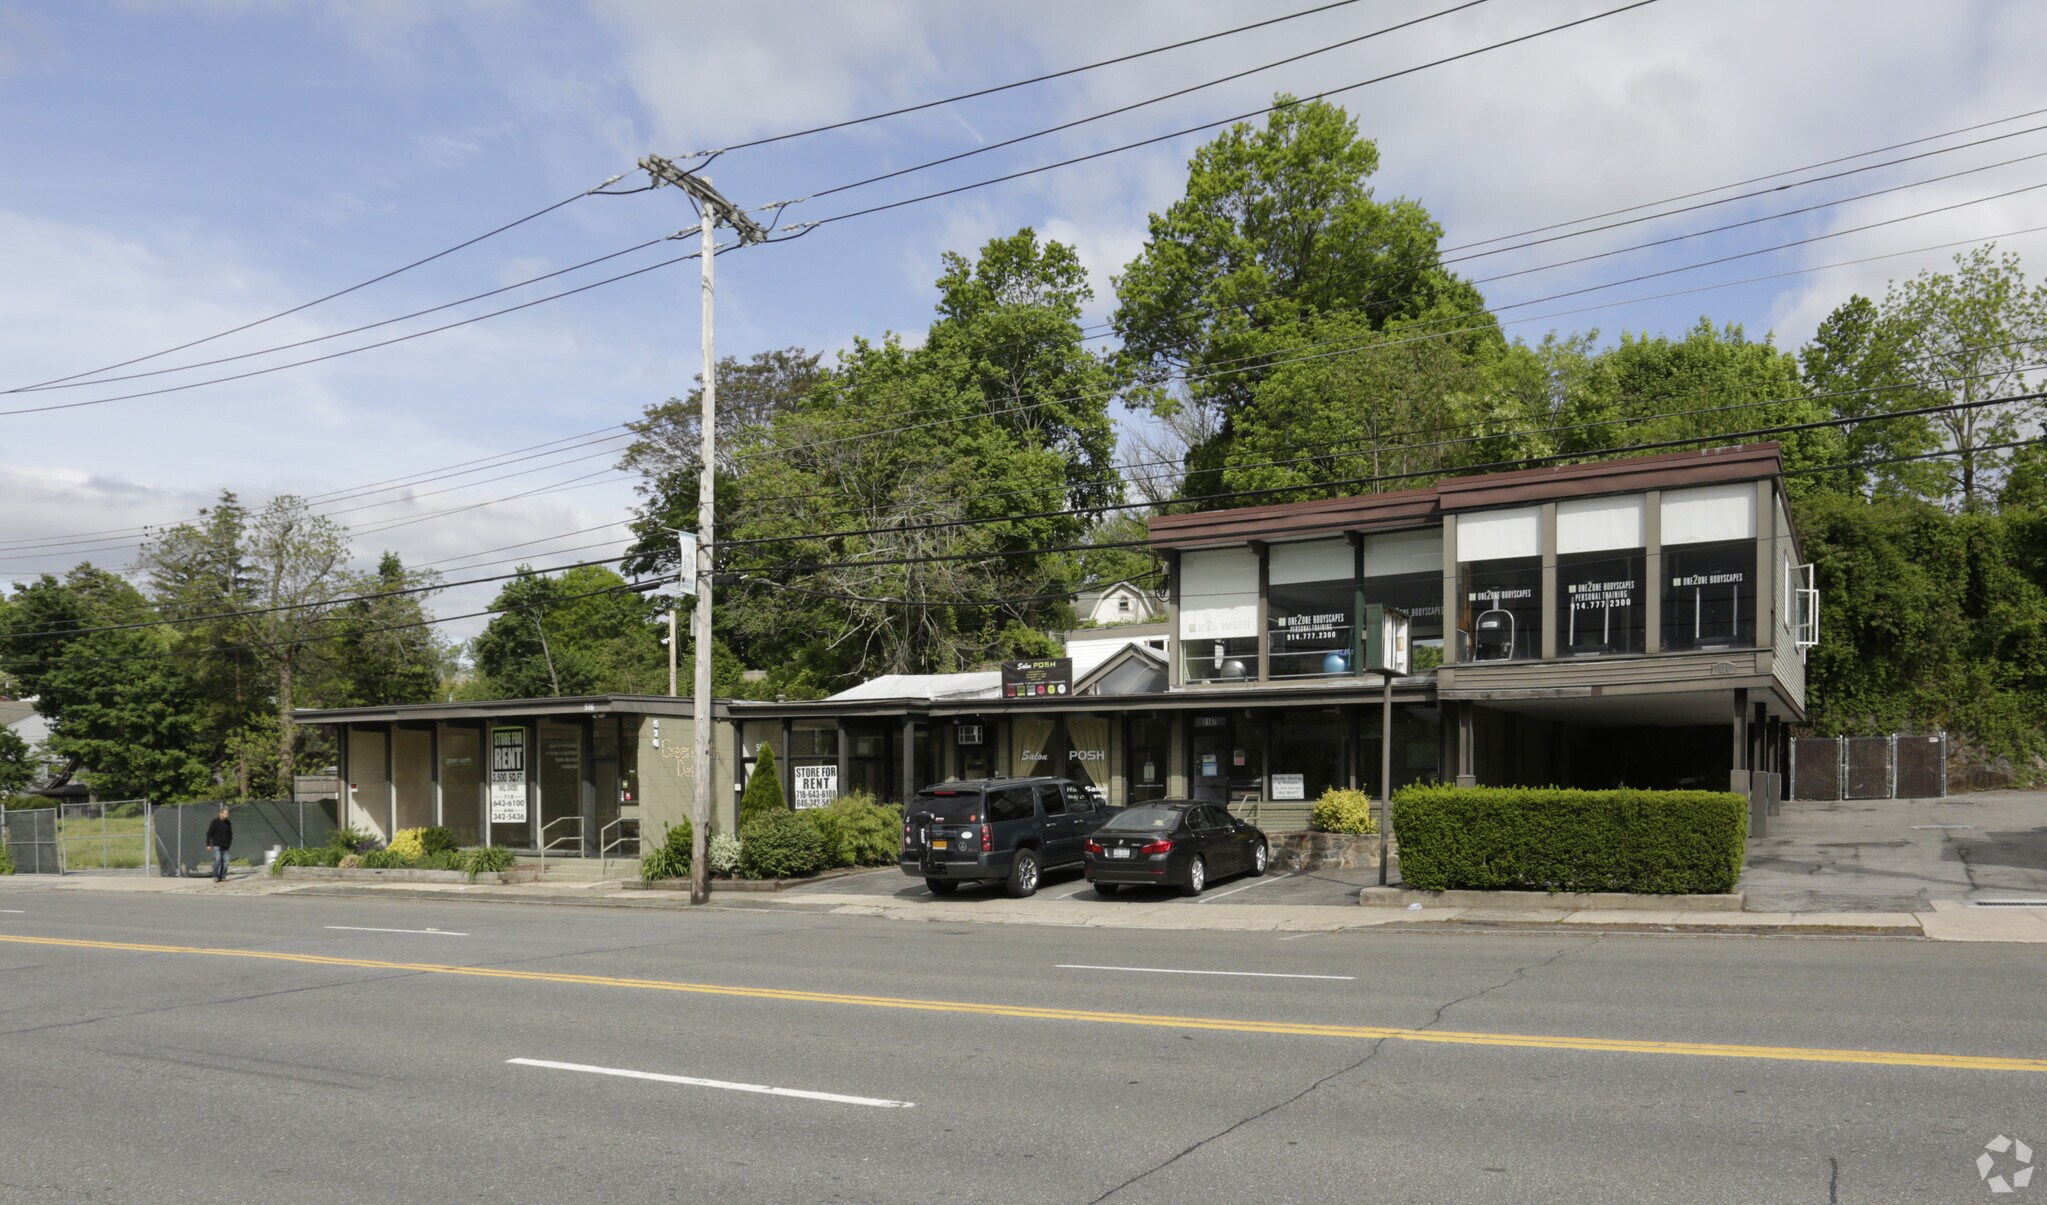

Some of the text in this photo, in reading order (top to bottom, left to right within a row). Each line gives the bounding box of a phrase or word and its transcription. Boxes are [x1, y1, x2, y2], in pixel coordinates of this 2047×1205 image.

[1710, 573, 1743, 584] BODYSCAPES
[1603, 581, 1634, 591] BODYSCAPES
[1502, 589, 1531, 599] BODYSCAPES
[1575, 590, 1627, 601] PERSONAL TRAINING
[1570, 598, 1631, 610] 914.7772300
[1313, 613, 1344, 624] BODYSCAPES
[1287, 631, 1336, 641] 914.777.2300
[1033, 661, 1056, 669] POSH
[494, 731, 522, 746] STORE FOR
[652, 719, 660, 748] 516
[494, 747, 522, 770] RENT
[1022, 750, 1104, 761] Salon POSH
[796, 766, 836, 778] STORE FOR
[493, 773, 524, 783] 3,500 SQ.FT.
[803, 778, 830, 790] RENT
[796, 789, 837, 799] 718-643-6100
[493, 813, 525, 821] 342-5436
